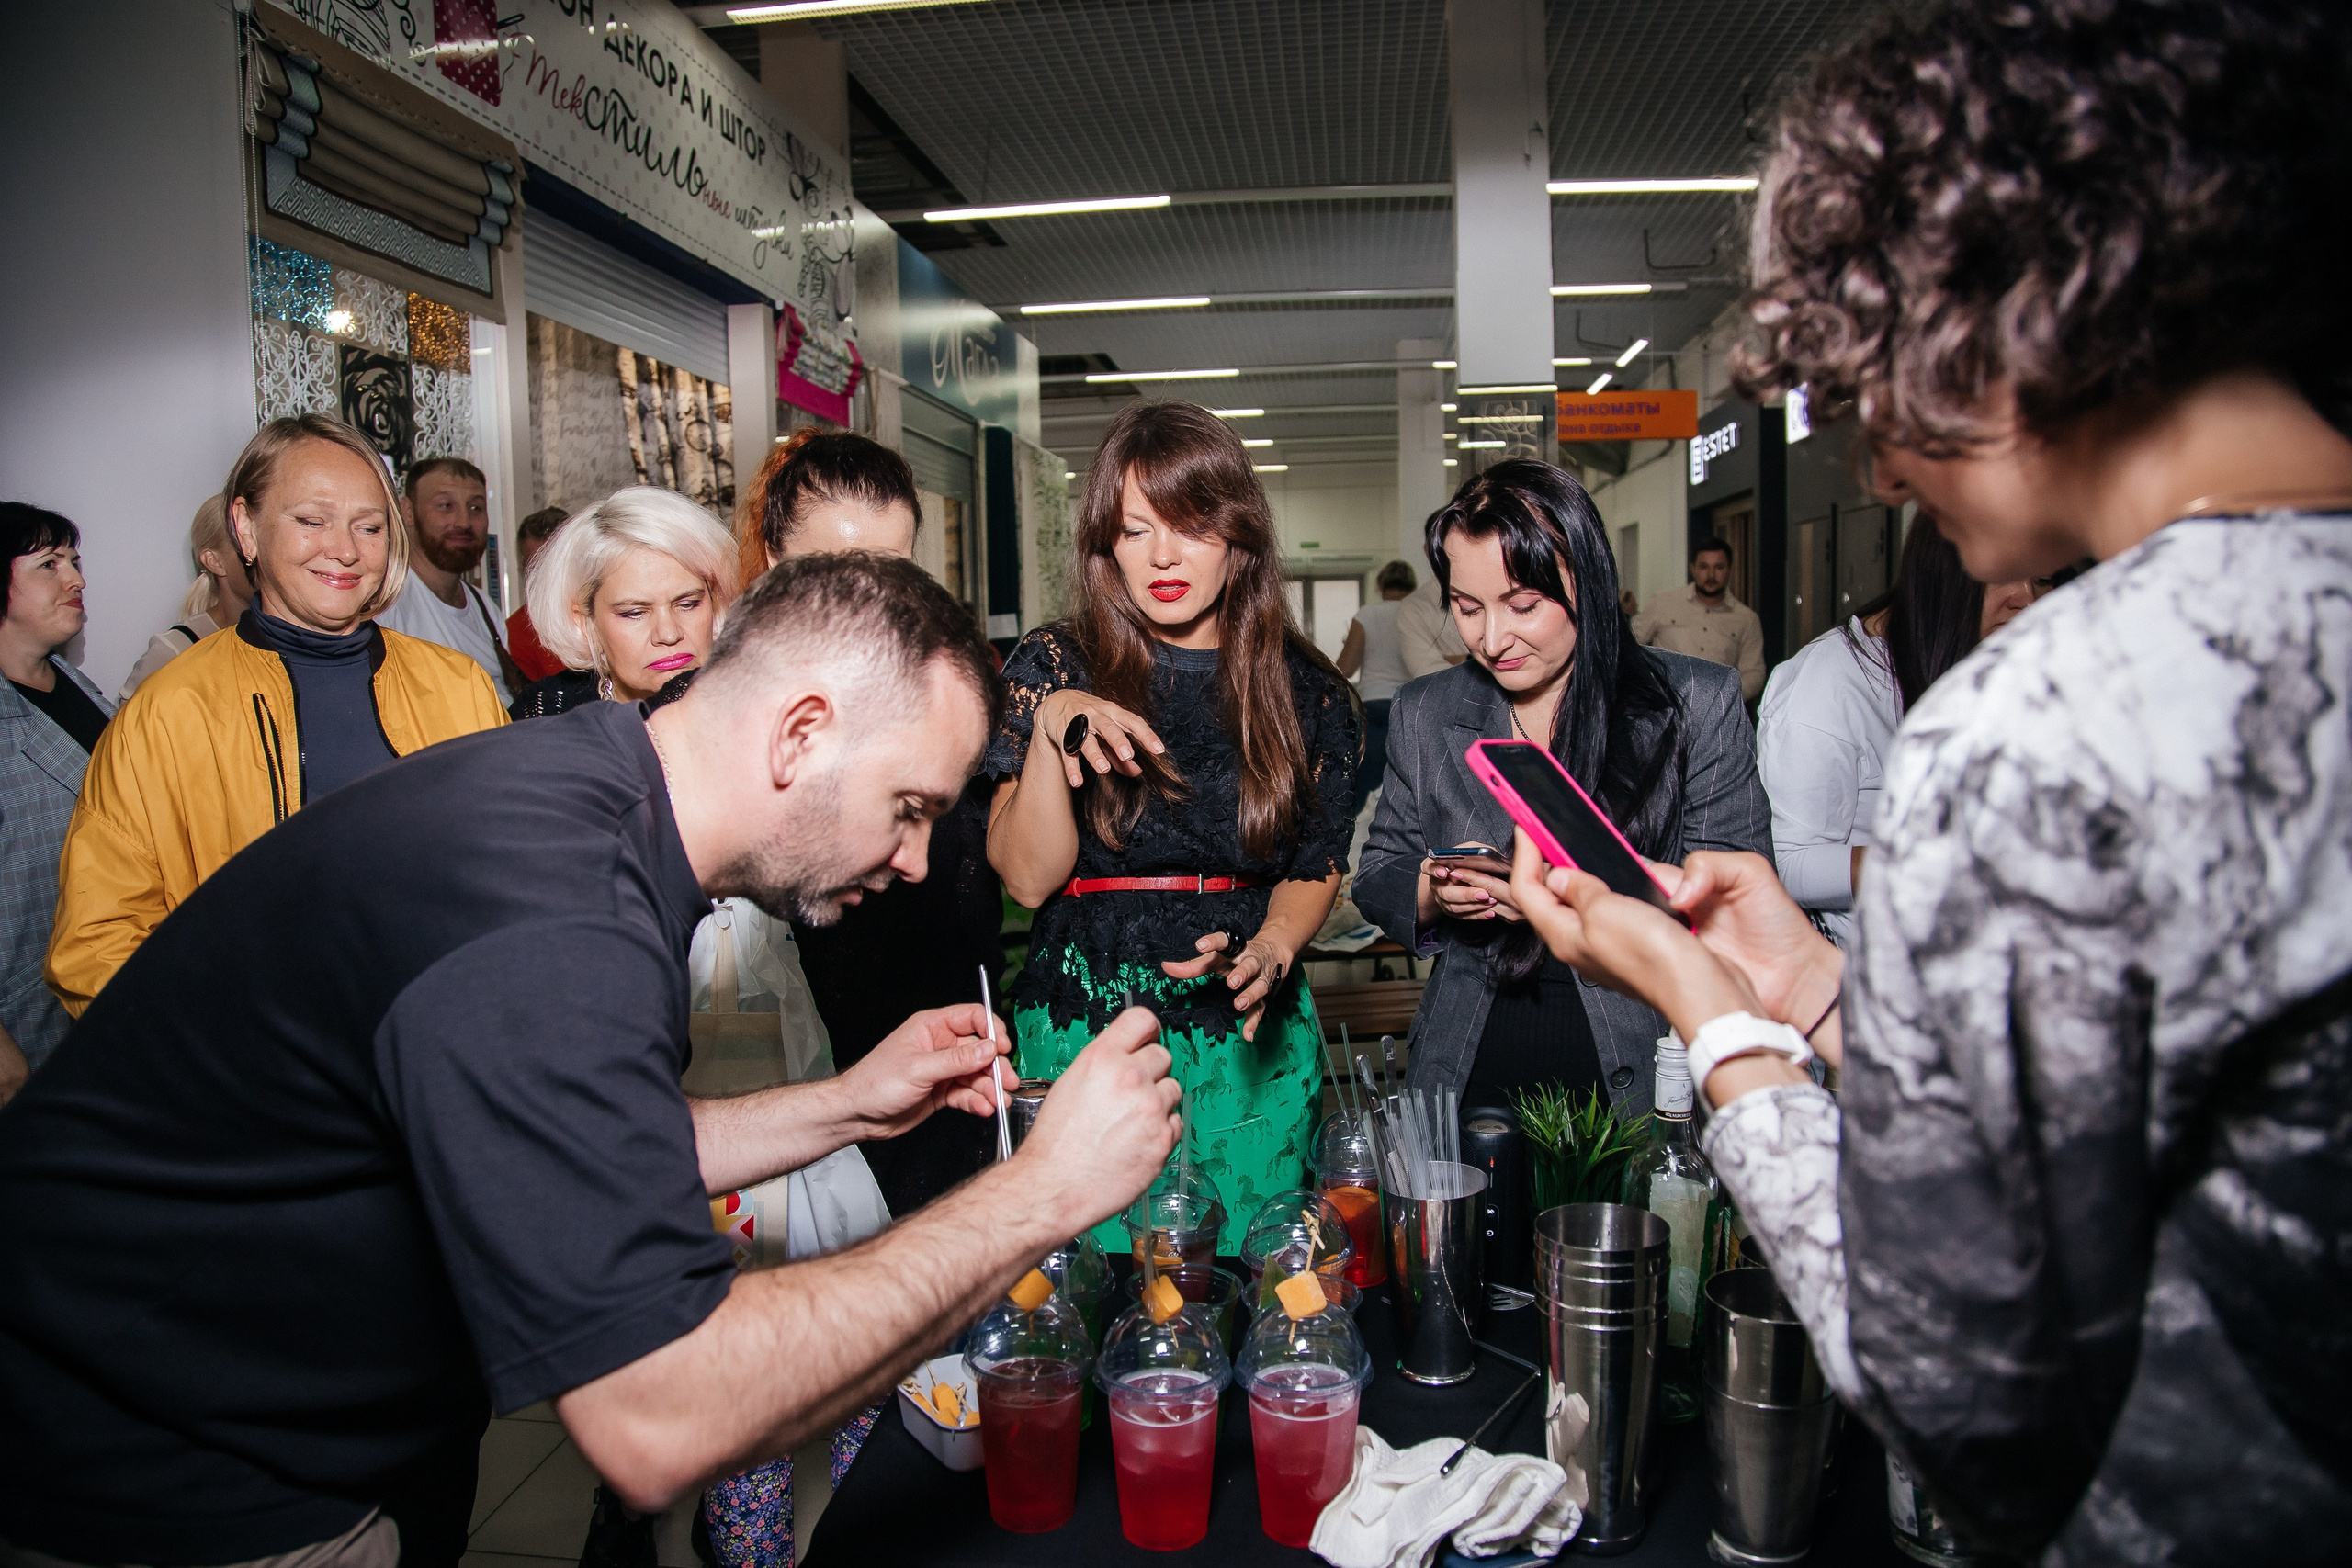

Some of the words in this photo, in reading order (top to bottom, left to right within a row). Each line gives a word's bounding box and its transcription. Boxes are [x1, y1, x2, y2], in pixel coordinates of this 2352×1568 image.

[603, 12, 695, 113] ДЕКОРА
[700, 87, 714, 128] И
[719, 103, 766, 166] ШТОР
[1558, 423, 1586, 434] она
[1703, 421, 1737, 461] ESTET
